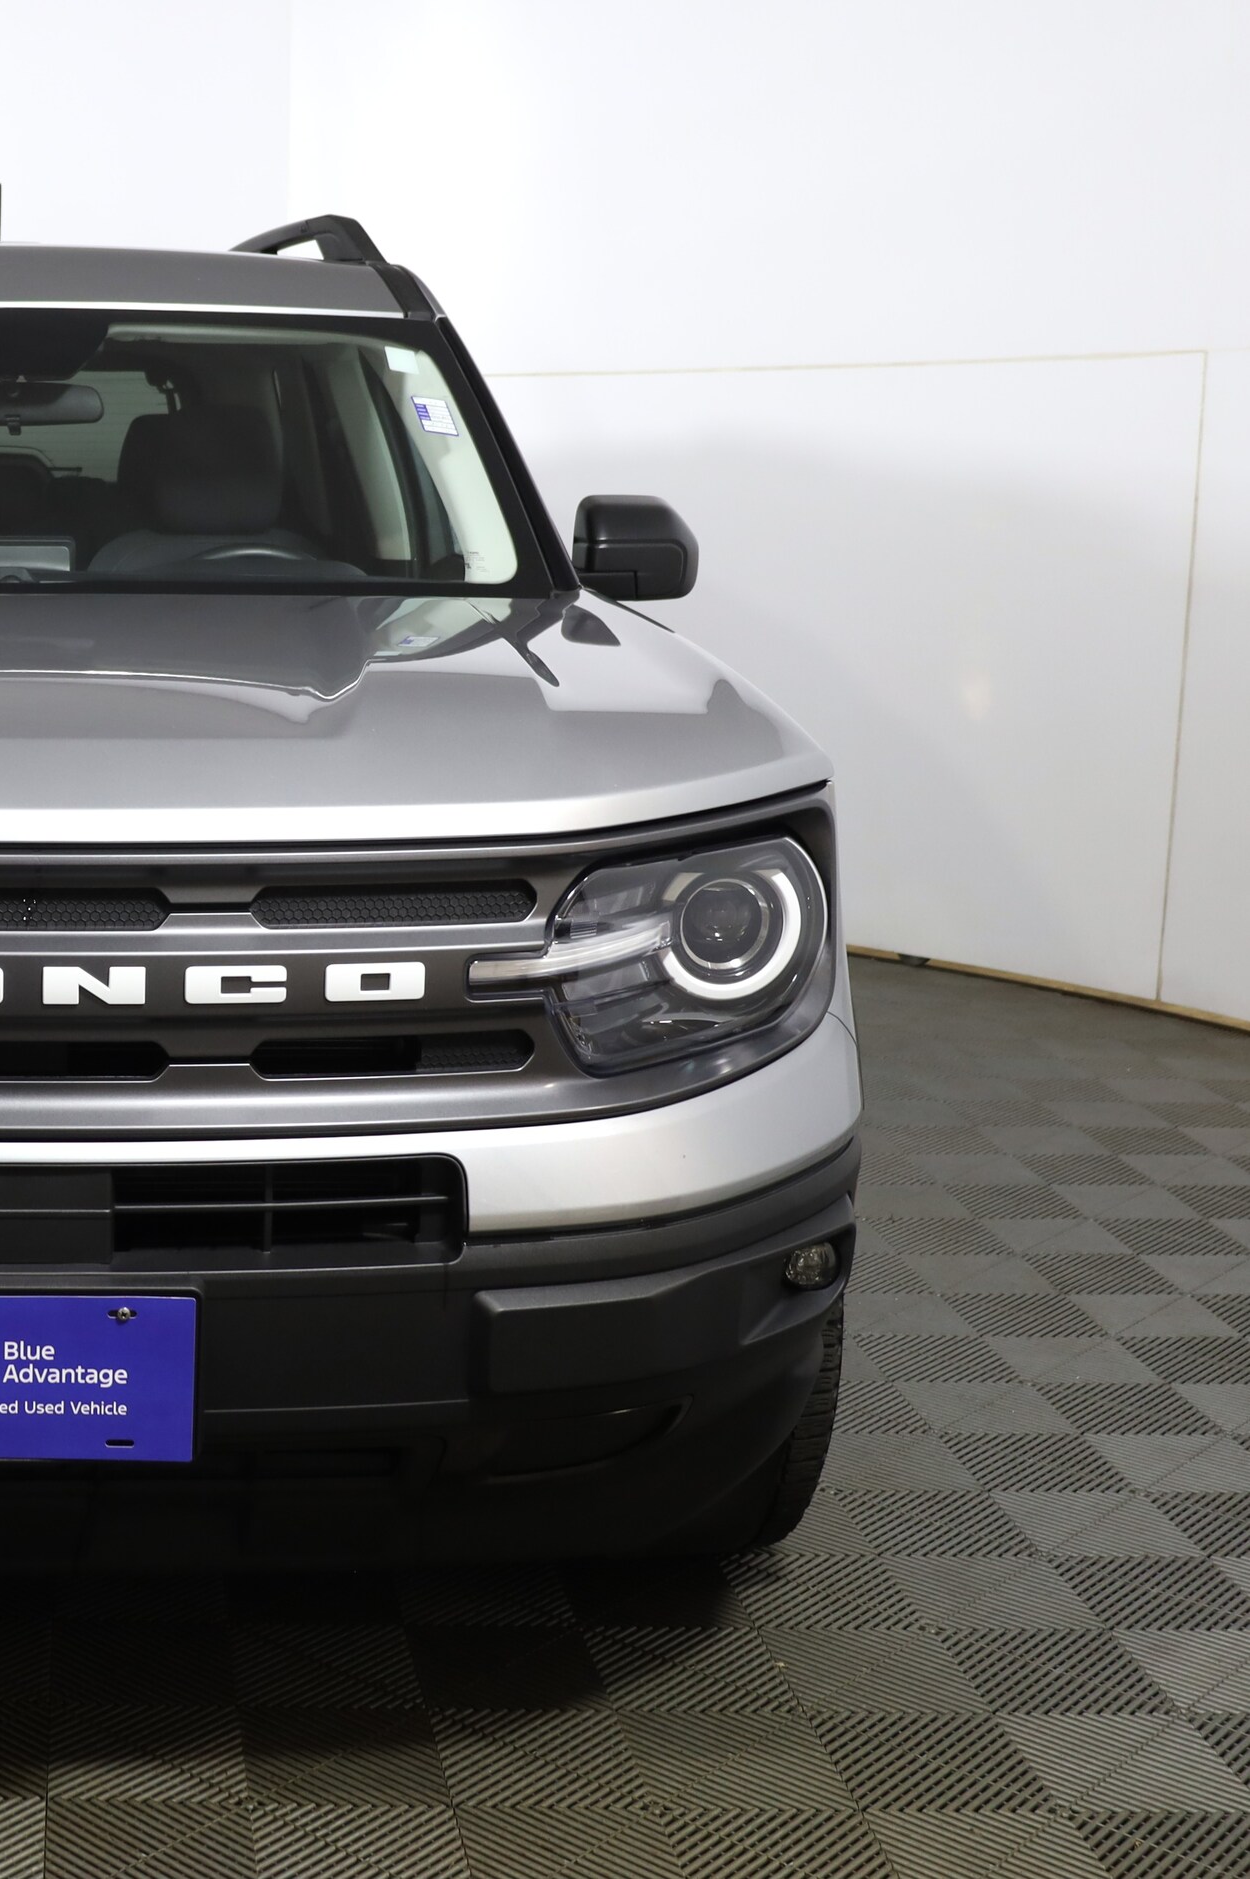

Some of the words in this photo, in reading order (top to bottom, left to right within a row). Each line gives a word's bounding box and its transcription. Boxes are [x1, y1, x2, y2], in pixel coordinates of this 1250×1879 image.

[3, 1340, 55, 1361] Blue
[2, 1363, 128, 1388] Advantage
[24, 1400, 65, 1415] Used
[70, 1401, 128, 1416] Vehicle
